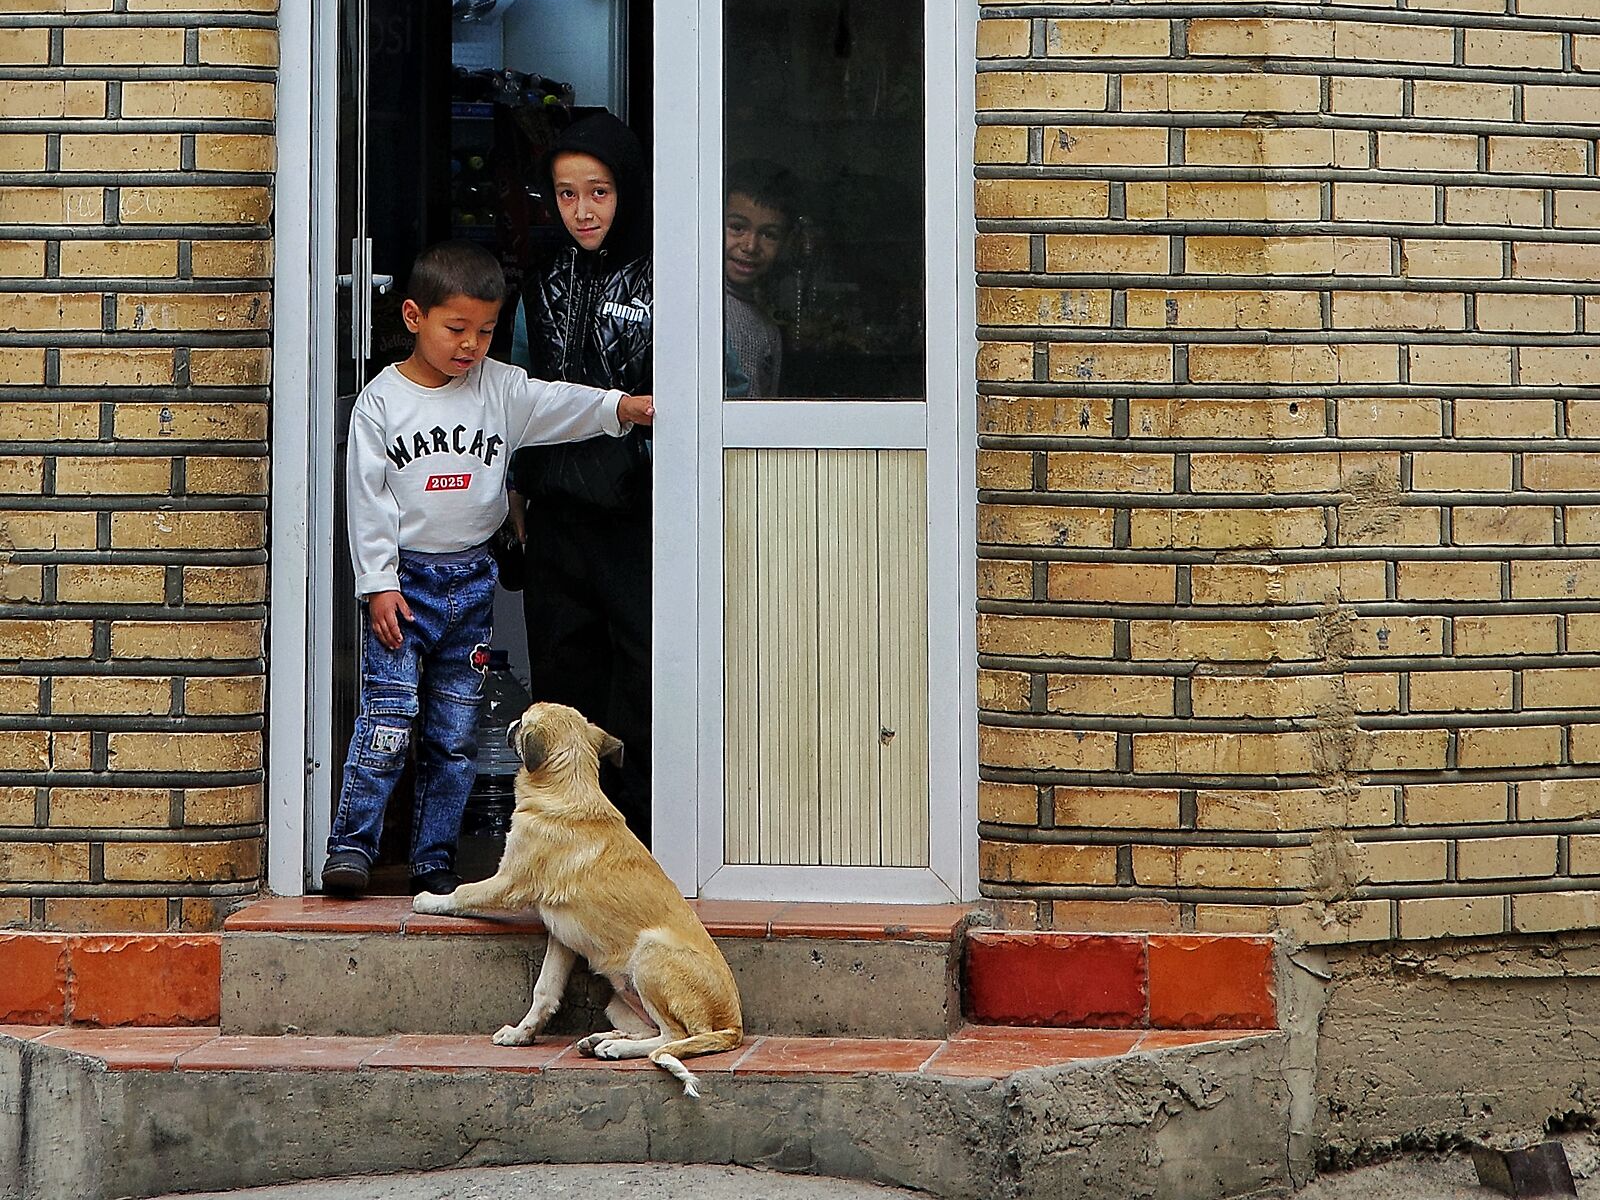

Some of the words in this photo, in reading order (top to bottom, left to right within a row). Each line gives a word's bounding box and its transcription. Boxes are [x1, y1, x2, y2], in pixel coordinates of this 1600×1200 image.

[602, 301, 644, 323] PUMA
[385, 423, 504, 471] WARCAF
[431, 476, 464, 489] 2025
